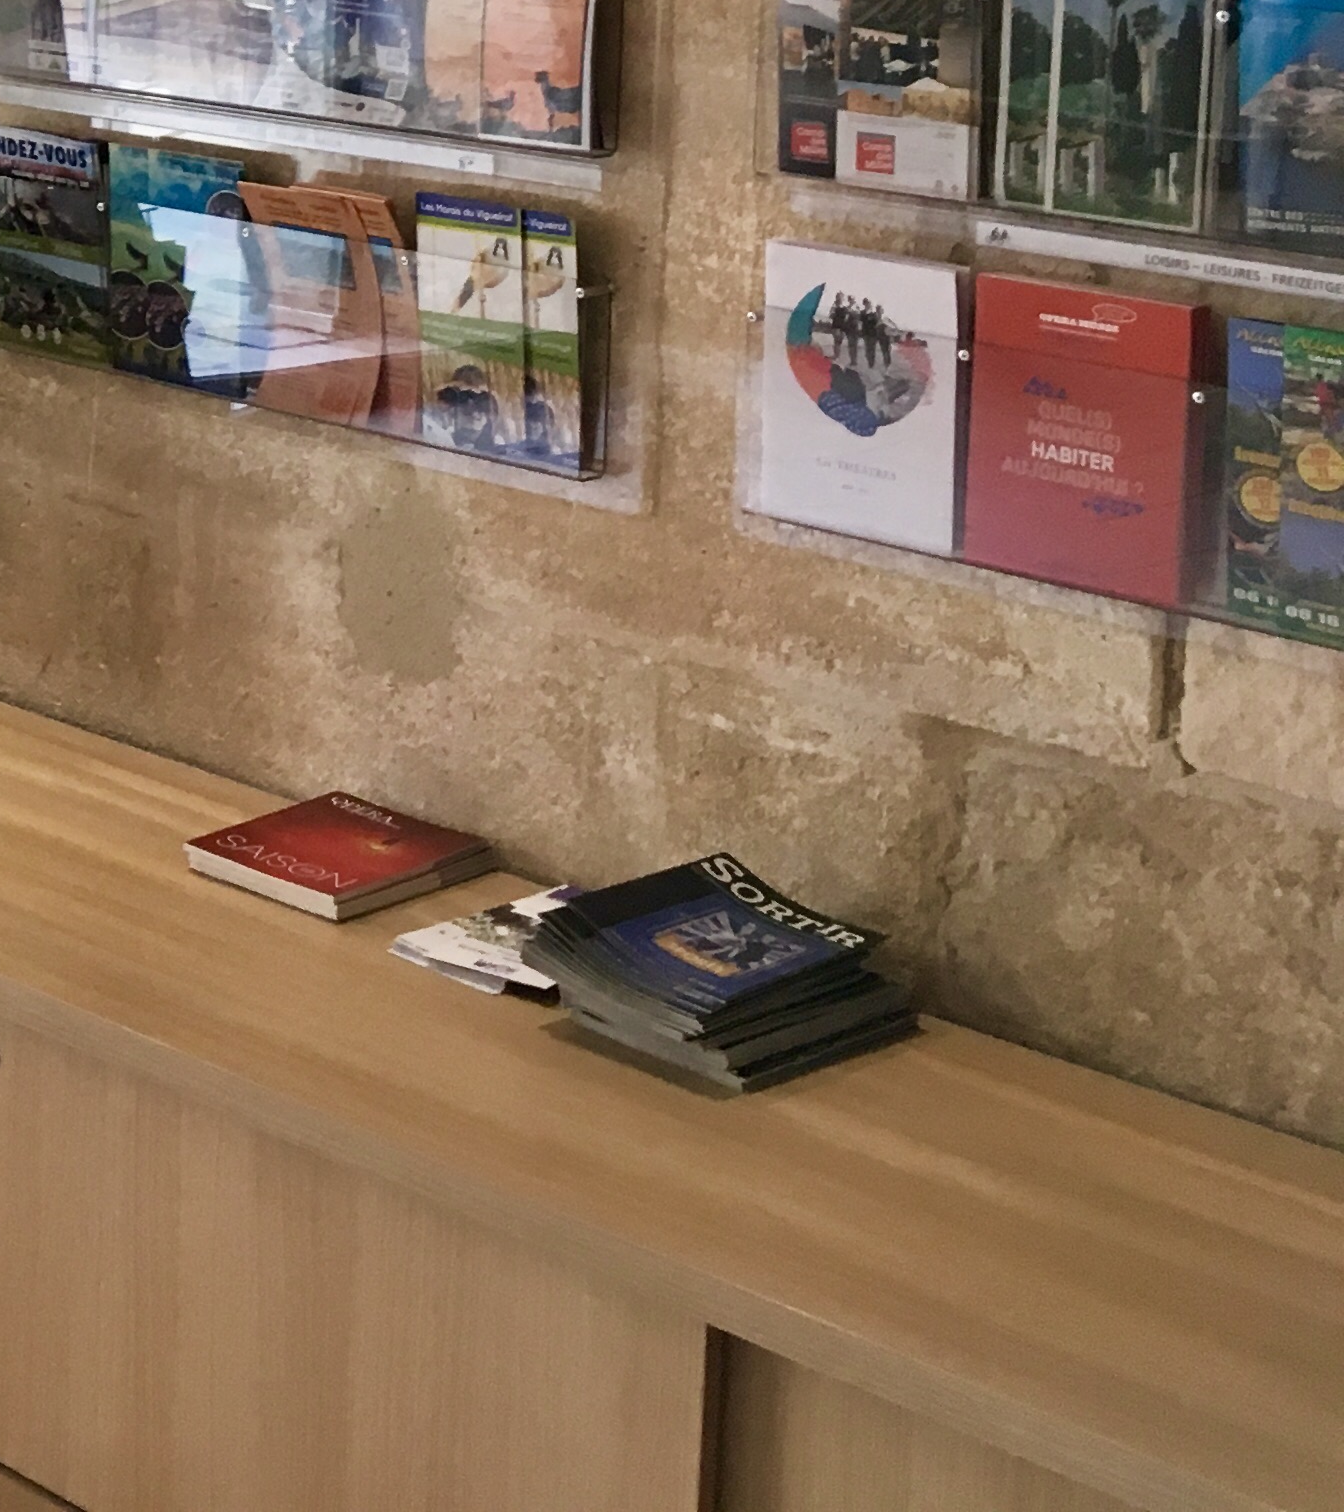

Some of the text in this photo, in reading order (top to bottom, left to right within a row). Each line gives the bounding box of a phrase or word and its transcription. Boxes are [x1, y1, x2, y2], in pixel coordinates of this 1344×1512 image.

[420, 201, 435, 212] Les
[463, 207, 475, 217] du
[1144, 253, 1261, 282] LOISIRS LEISURES
[1030, 439, 1115, 473] HABITER
[215, 832, 359, 889] SAISON
[700, 857, 866, 949] SORTIR
